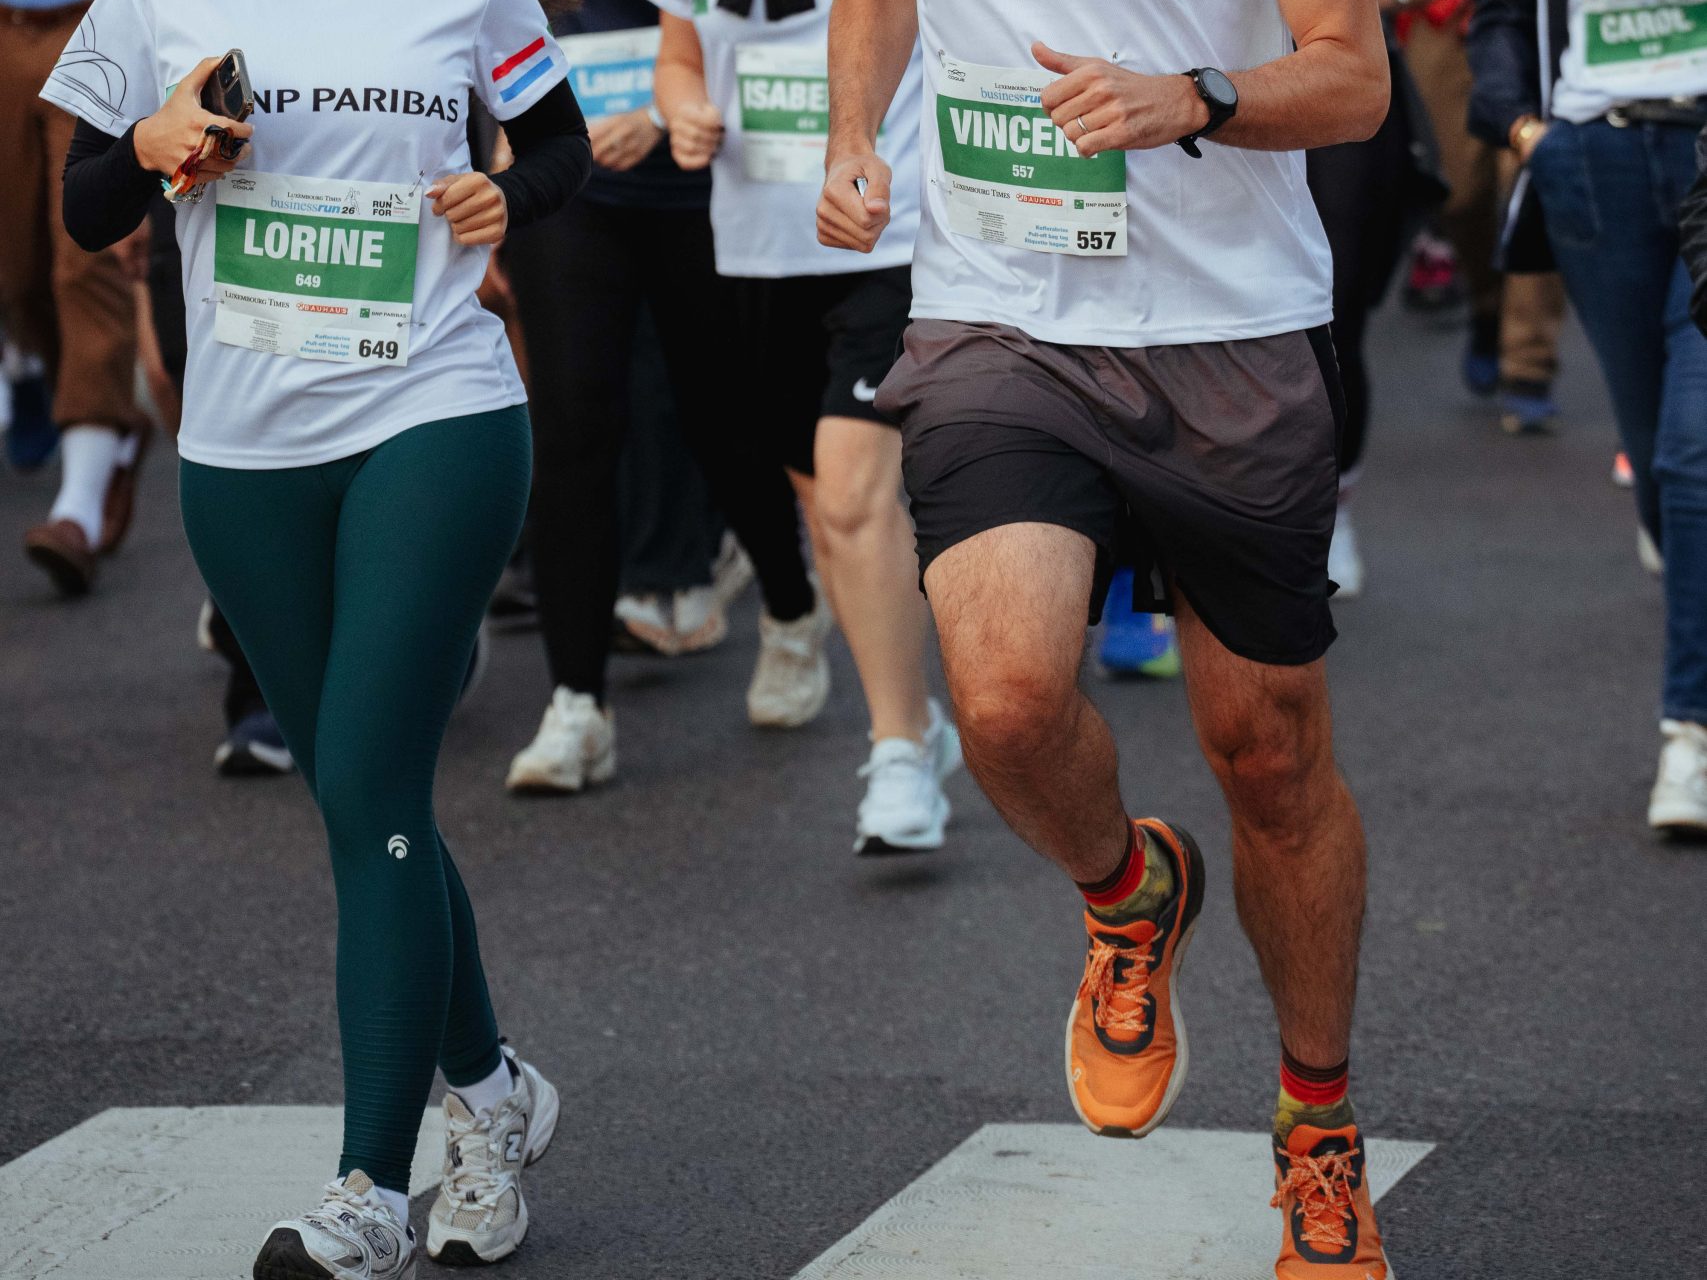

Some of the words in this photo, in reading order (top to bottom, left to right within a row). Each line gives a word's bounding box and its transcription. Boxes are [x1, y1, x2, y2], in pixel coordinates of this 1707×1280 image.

[743, 78, 827, 112] ISABE
[251, 88, 301, 115] NP
[312, 87, 459, 123] PARIBAS
[1012, 164, 1034, 179] 557
[952, 181, 990, 195] LUXEMBOURG
[991, 188, 1011, 199] TIMES
[372, 200, 392, 209] RUN
[1023, 196, 1062, 205] BAUHAUS
[341, 206, 355, 215] 26
[372, 208, 392, 217] FOR
[243, 218, 385, 268] LORINE
[1076, 230, 1117, 250] 557
[295, 273, 321, 288] 649
[225, 290, 267, 306] LUXEMBOURG
[268, 298, 290, 309] TIMES
[304, 305, 348, 314] BAUHAUS
[358, 339, 399, 360] 649
